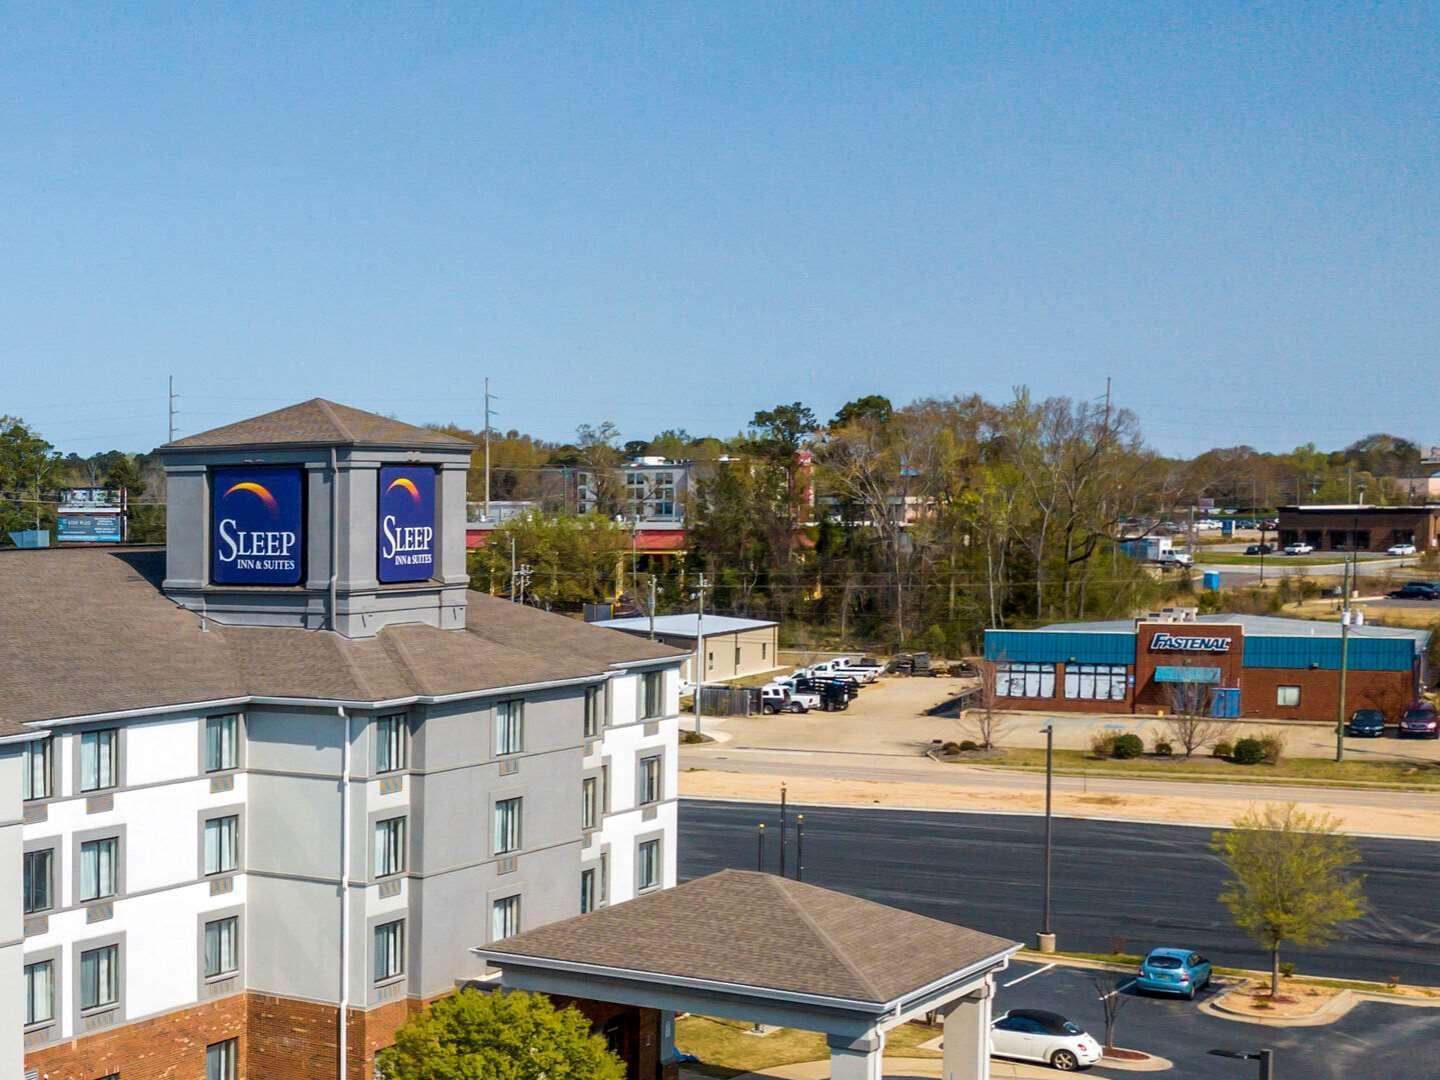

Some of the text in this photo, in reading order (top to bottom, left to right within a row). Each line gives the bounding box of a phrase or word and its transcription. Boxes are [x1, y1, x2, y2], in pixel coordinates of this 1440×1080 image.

[219, 518, 296, 562] SLEEP
[383, 515, 433, 559] SLEEP
[237, 559, 295, 570] INN & SUITES
[395, 555, 407, 566] INN
[412, 553, 433, 564] SUITES
[1150, 632, 1232, 651] FASTENAL
